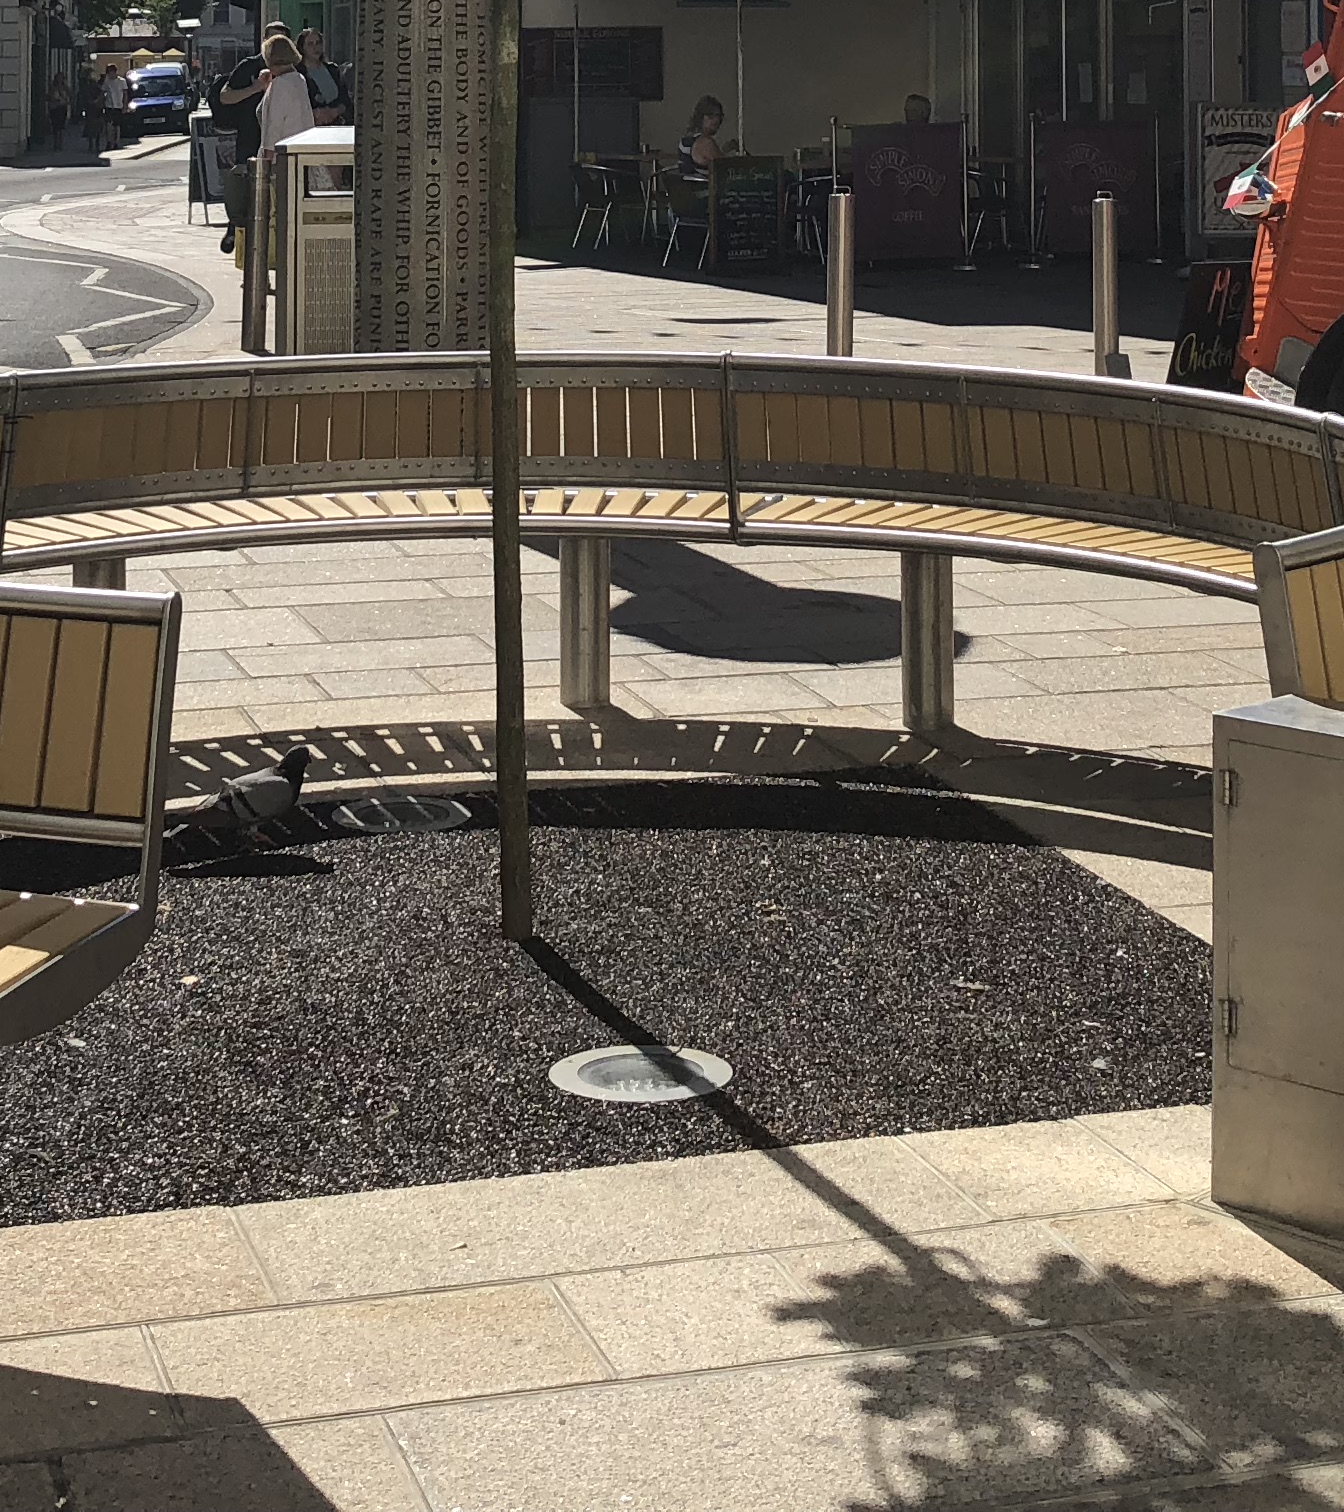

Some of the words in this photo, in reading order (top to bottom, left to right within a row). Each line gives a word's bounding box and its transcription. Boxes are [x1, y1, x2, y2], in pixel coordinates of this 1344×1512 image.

[455, 1, 468, 41] THE
[426, 35, 442, 74] THE
[455, 48, 469, 104] BODY
[476, 15, 487, 127] HOMICIDE
[371, 60, 384, 132] INCEST
[396, 33, 412, 139] ADULTERY
[425, 79, 442, 154] GIBBET
[455, 110, 469, 155] AND
[1210, 112, 1274, 128] MISTERS
[371, 137, 383, 182] AND
[396, 142, 412, 183] THE
[455, 161, 468, 189] OF
[869, 150, 909, 175] SIMPLE
[371, 188, 383, 239] RAPE
[455, 194, 468, 271] GOODS
[893, 210, 924, 222] COFFEE
[425, 172, 441, 314] FORNICATION
[371, 247, 383, 287] ARE
[395, 254, 411, 295] FOR
[1175, 332, 1233, 376] Chicken
